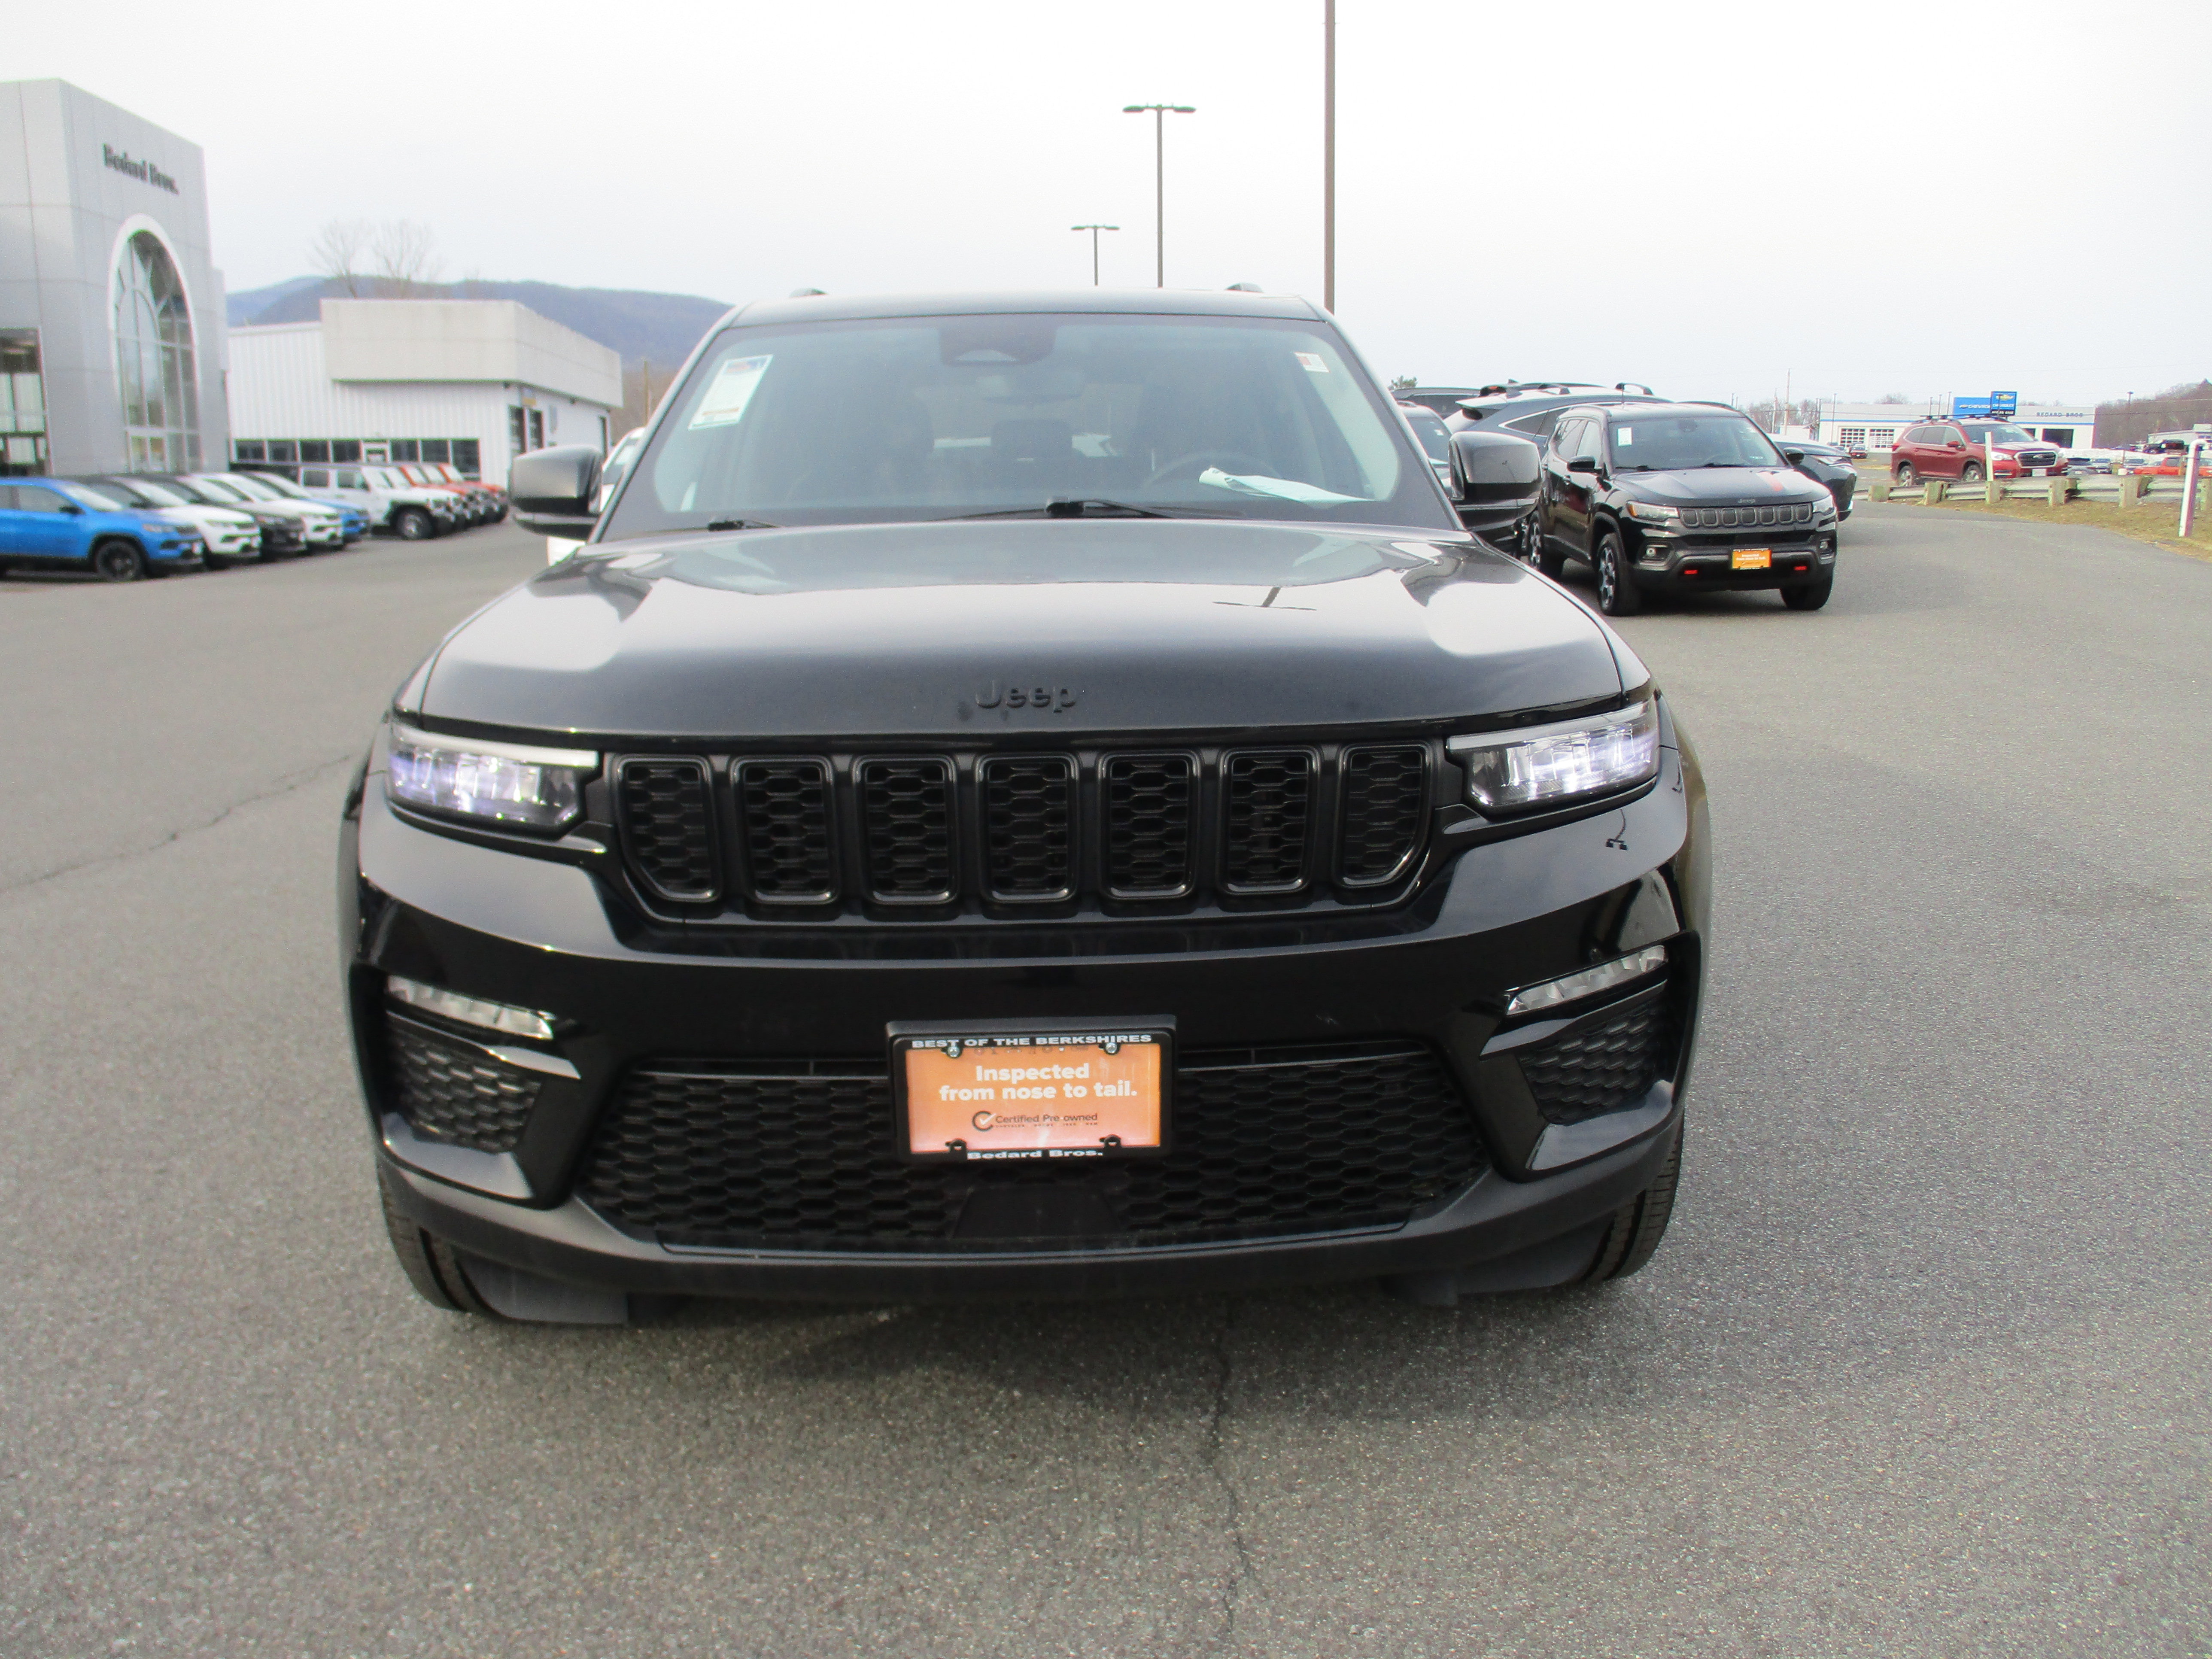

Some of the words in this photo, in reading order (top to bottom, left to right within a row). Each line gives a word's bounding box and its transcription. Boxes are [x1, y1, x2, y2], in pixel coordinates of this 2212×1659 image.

[974, 679, 1077, 714] Jeep
[912, 1039, 960, 1048] BEST
[964, 1038, 989, 1047] OF
[993, 1037, 1030, 1046] THE
[1035, 1034, 1152, 1045] BERKSHIRES
[975, 1062, 1090, 1085] Inspected
[939, 1085, 995, 1101] from
[1002, 1085, 1057, 1100] nose
[1063, 1082, 1088, 1098] to
[1093, 1079, 1138, 1097] tail.
[995, 1114, 1039, 1124] Certified
[966, 1150, 1042, 1160] Bedard
[1048, 1149, 1103, 1158] Bros.
